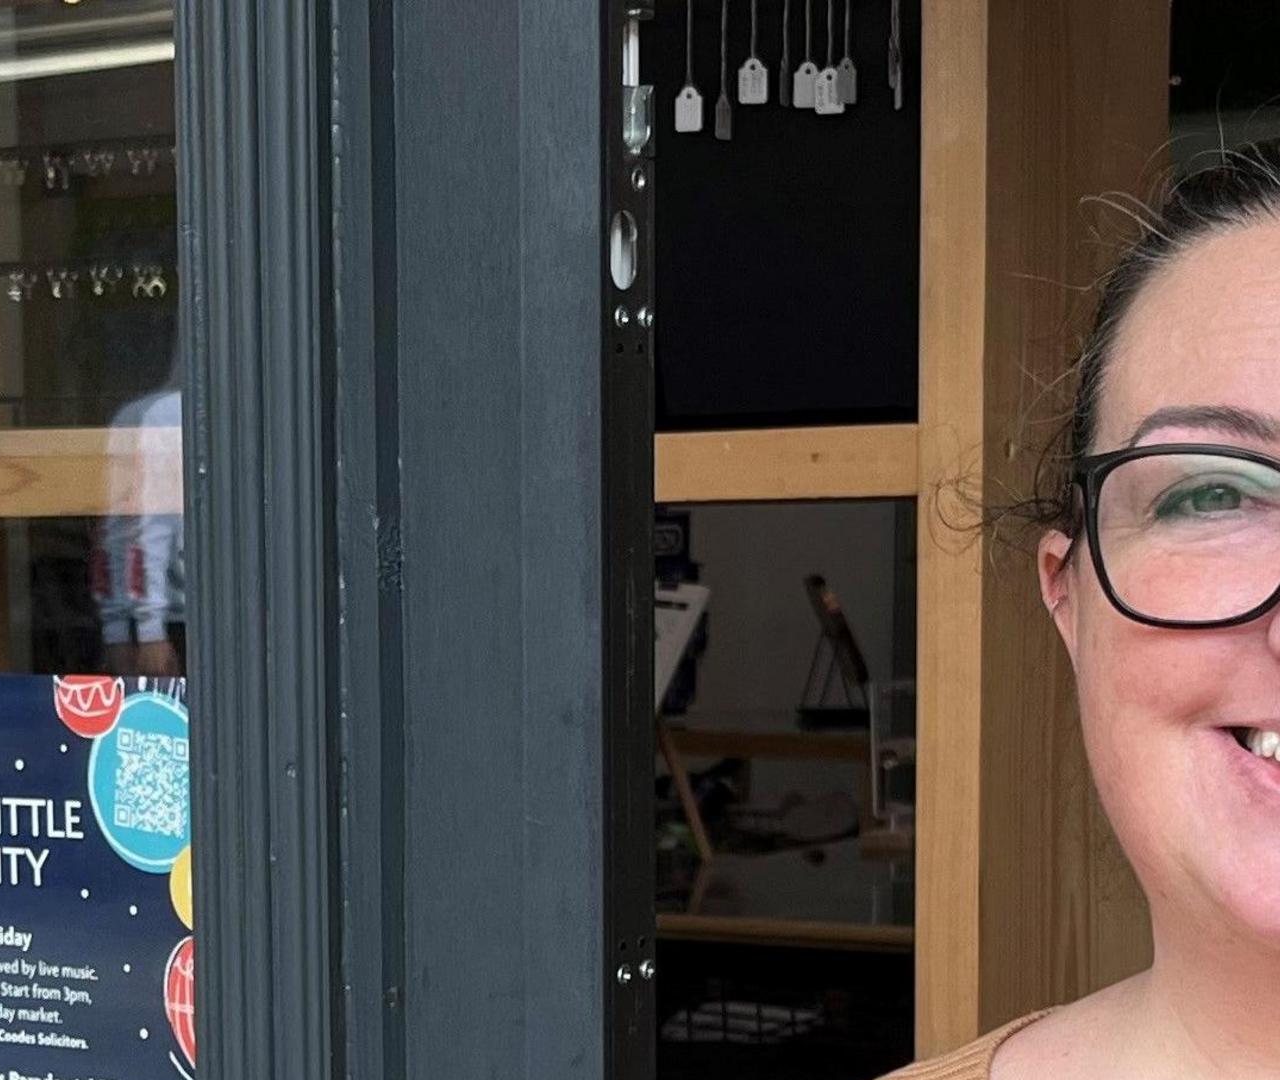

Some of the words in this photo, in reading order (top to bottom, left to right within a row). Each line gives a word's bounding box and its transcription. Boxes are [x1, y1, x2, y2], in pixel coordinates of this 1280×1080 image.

[20, 958, 37, 980] by
[37, 959, 60, 978] live
[0, 980, 31, 999] Start
[31, 982, 62, 1001] from
